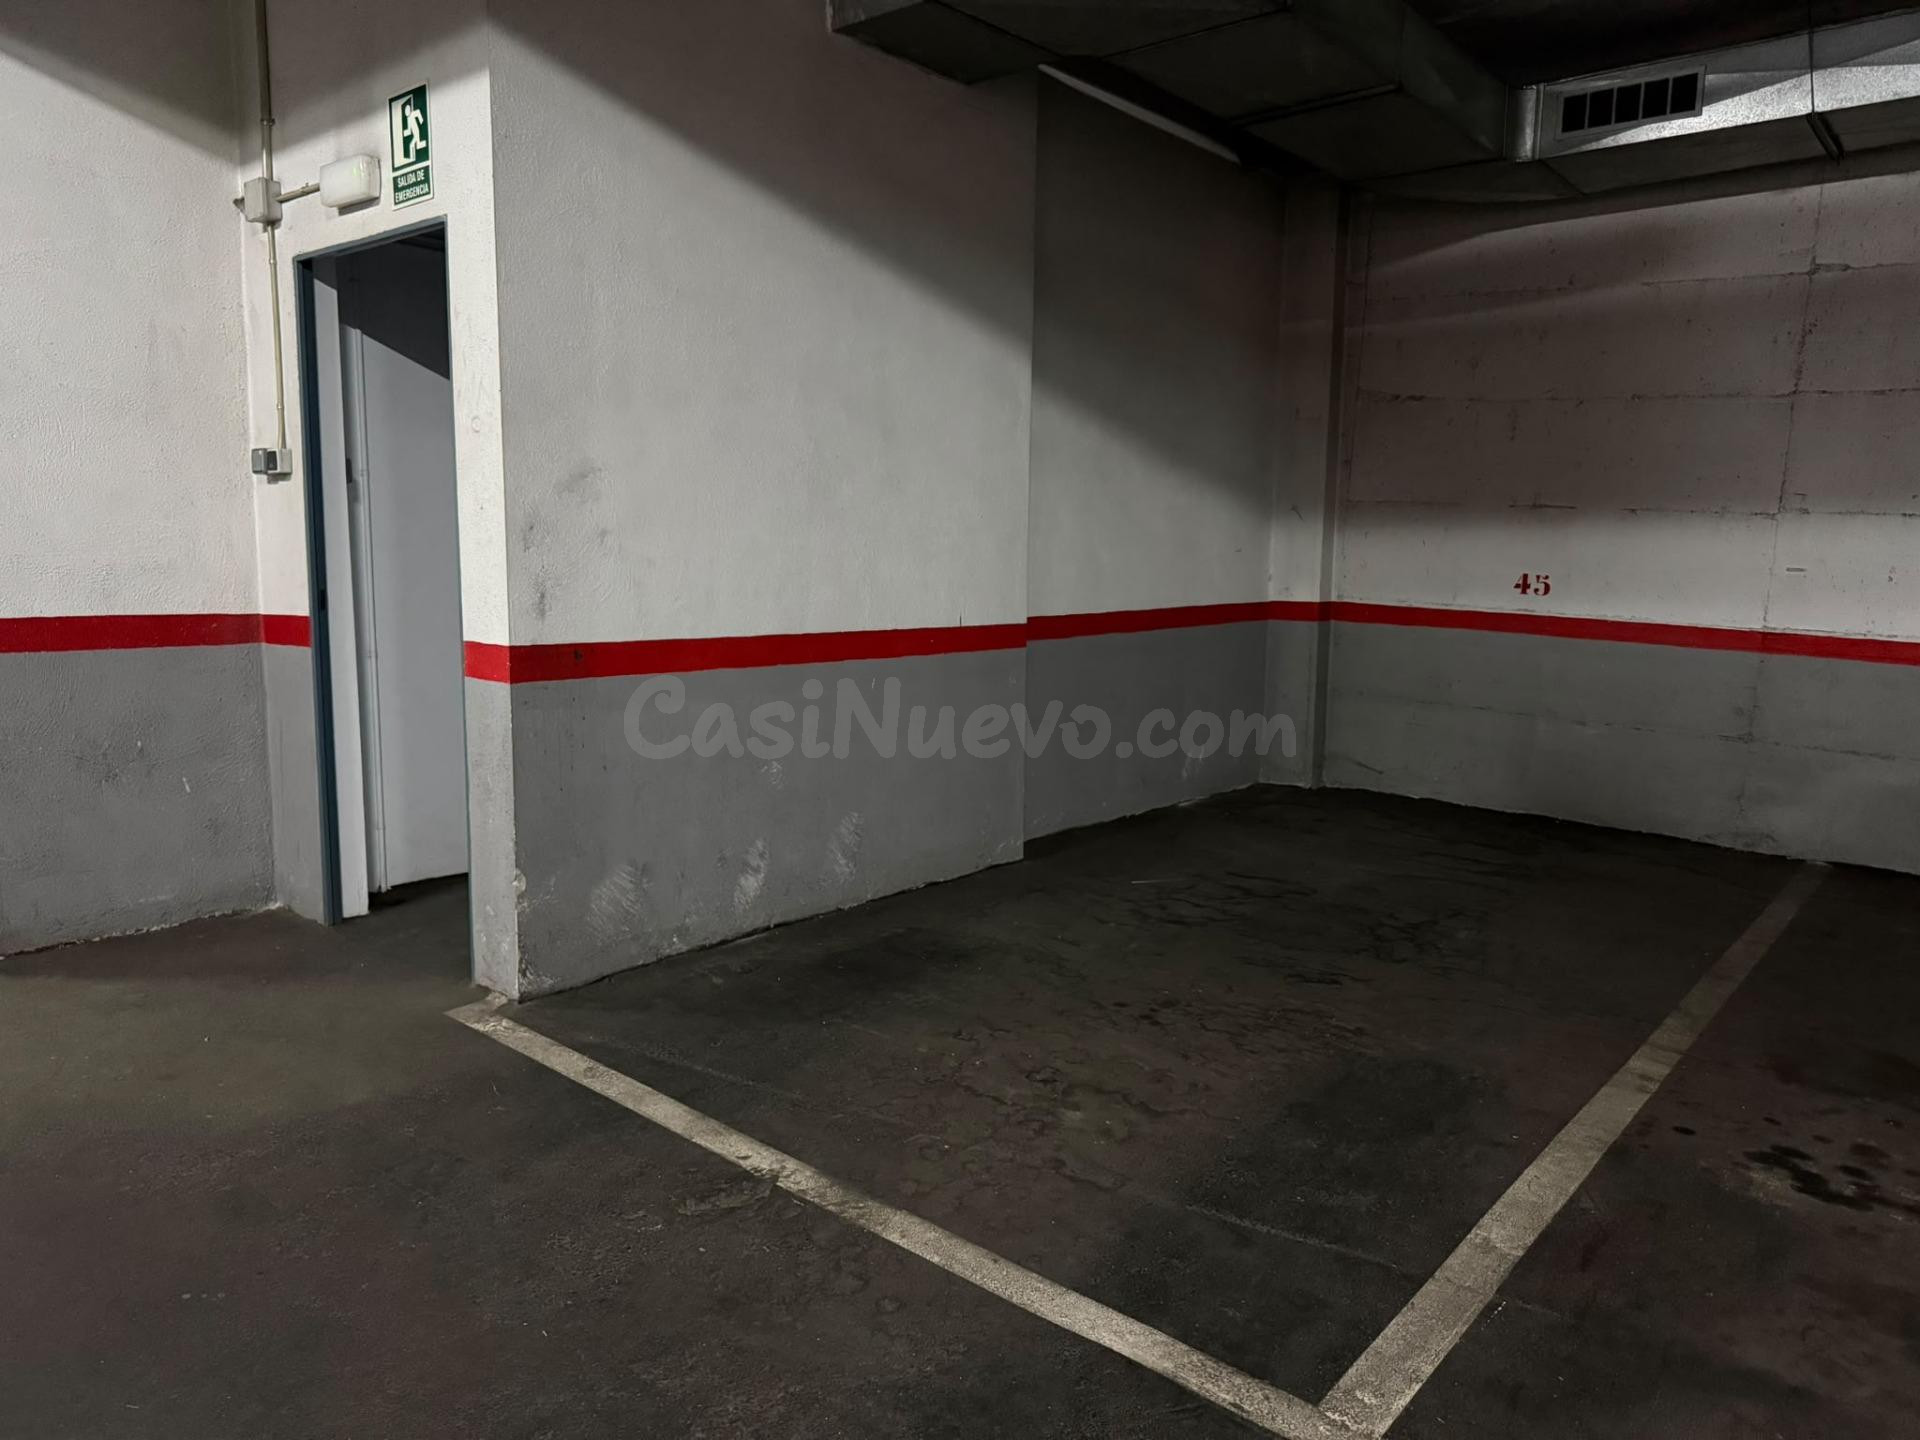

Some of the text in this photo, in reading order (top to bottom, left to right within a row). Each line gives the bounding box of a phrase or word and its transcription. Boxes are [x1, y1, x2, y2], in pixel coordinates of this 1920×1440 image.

[397, 169, 425, 188] SALIDA DE
[395, 183, 429, 203] EMERGENCIA
[1513, 573, 1551, 596] 45
